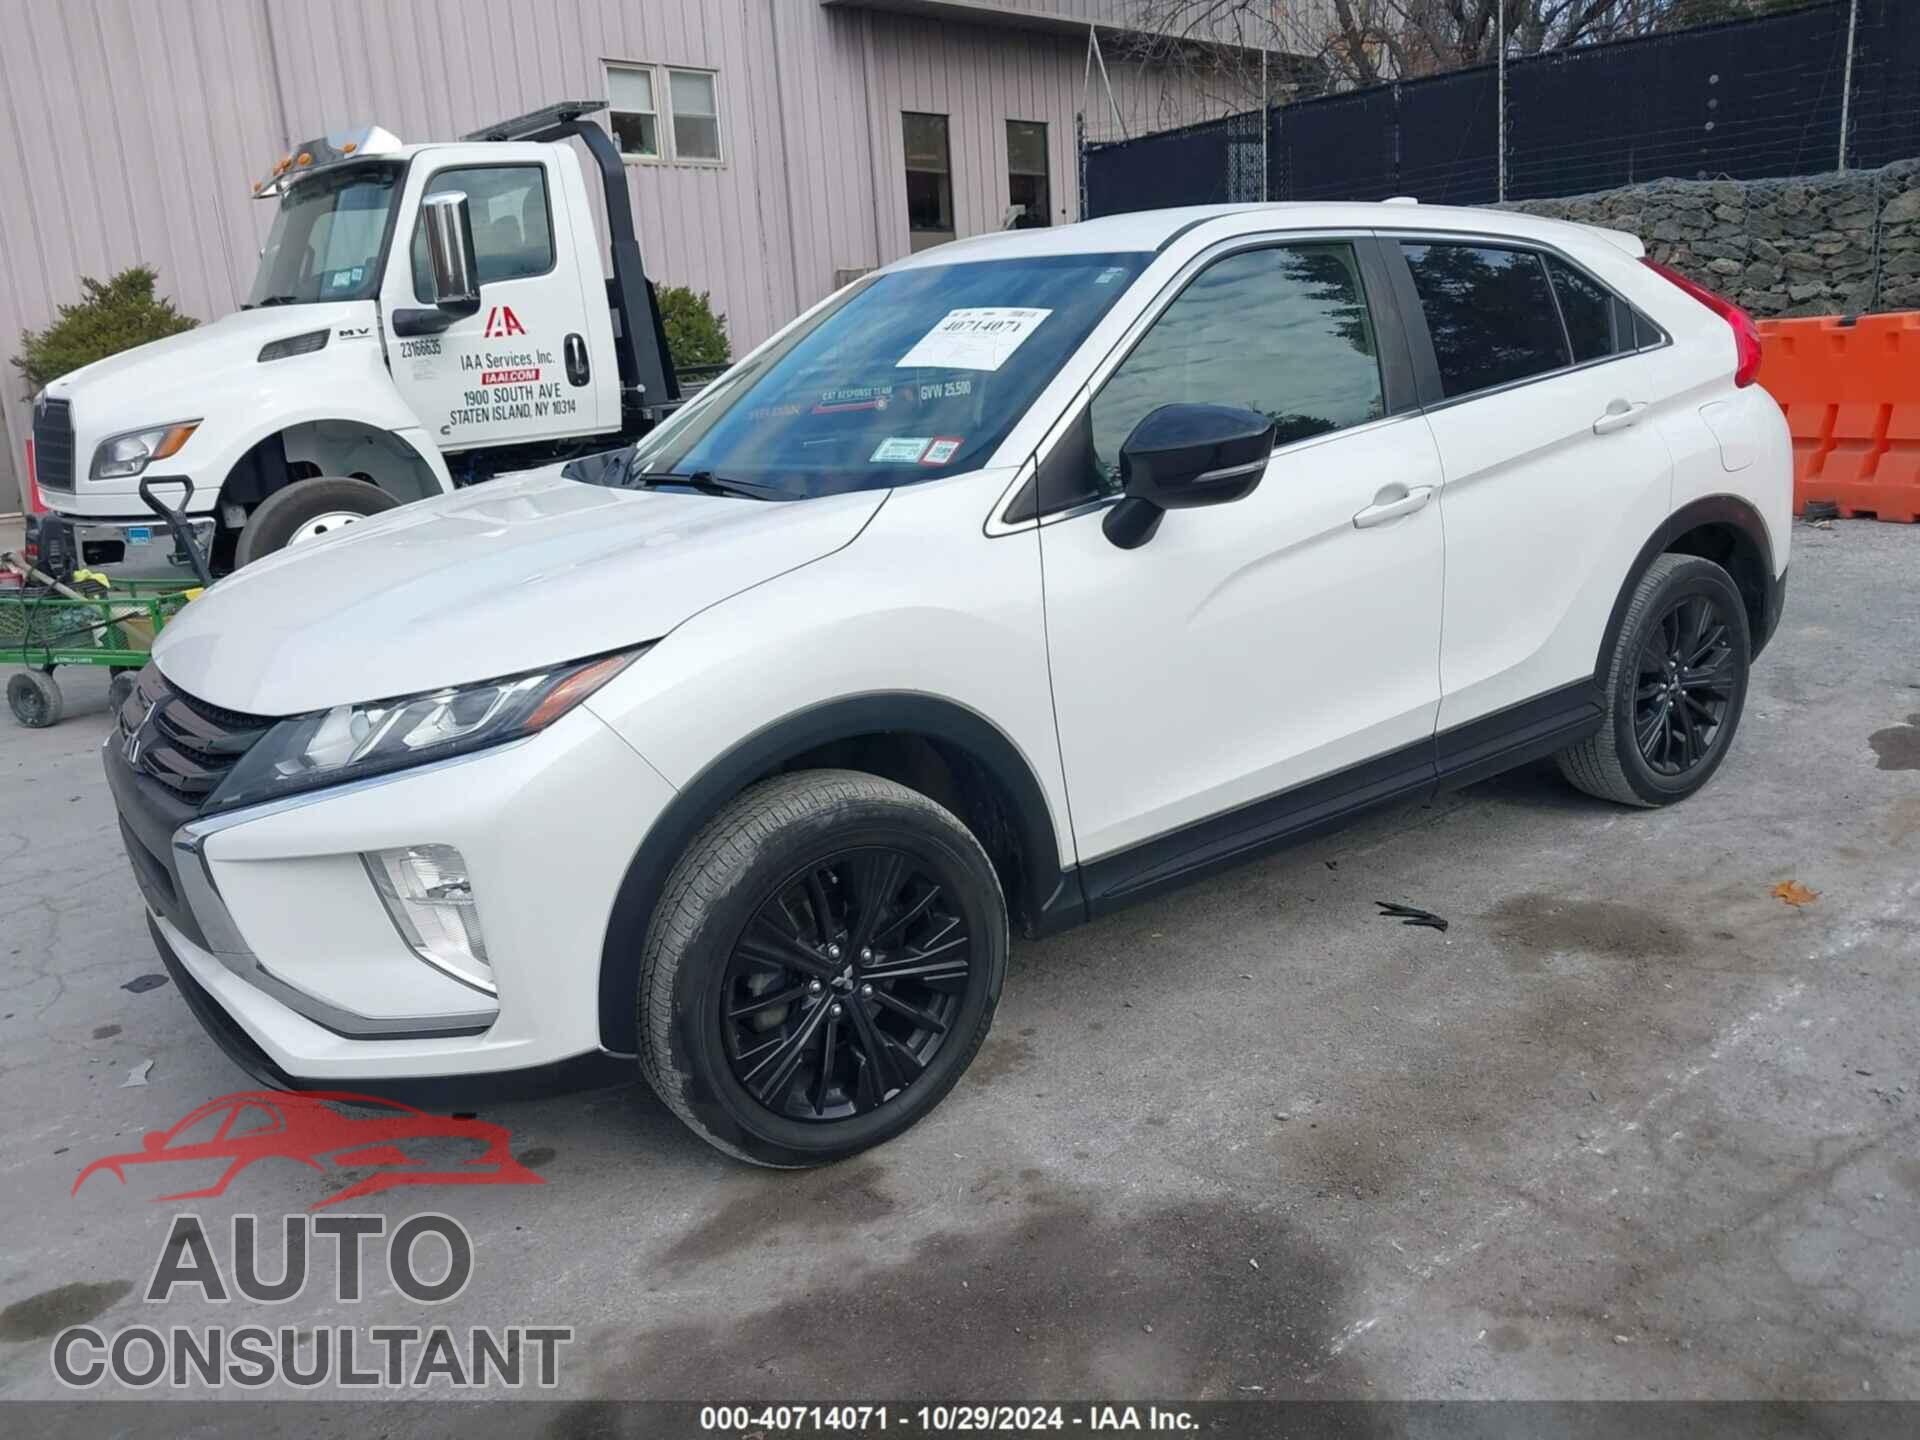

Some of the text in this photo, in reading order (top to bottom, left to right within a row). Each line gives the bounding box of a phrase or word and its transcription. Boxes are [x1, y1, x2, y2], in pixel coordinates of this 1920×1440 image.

[339, 328, 369, 336] MV
[460, 350, 555, 371] IAA Services, Inc.
[464, 382, 562, 407] 1900 SOUTH AVE
[920, 384, 943, 400] GVW
[450, 408, 491, 426] STATEN
[535, 401, 550, 417] NY
[552, 399, 577, 415] 10314
